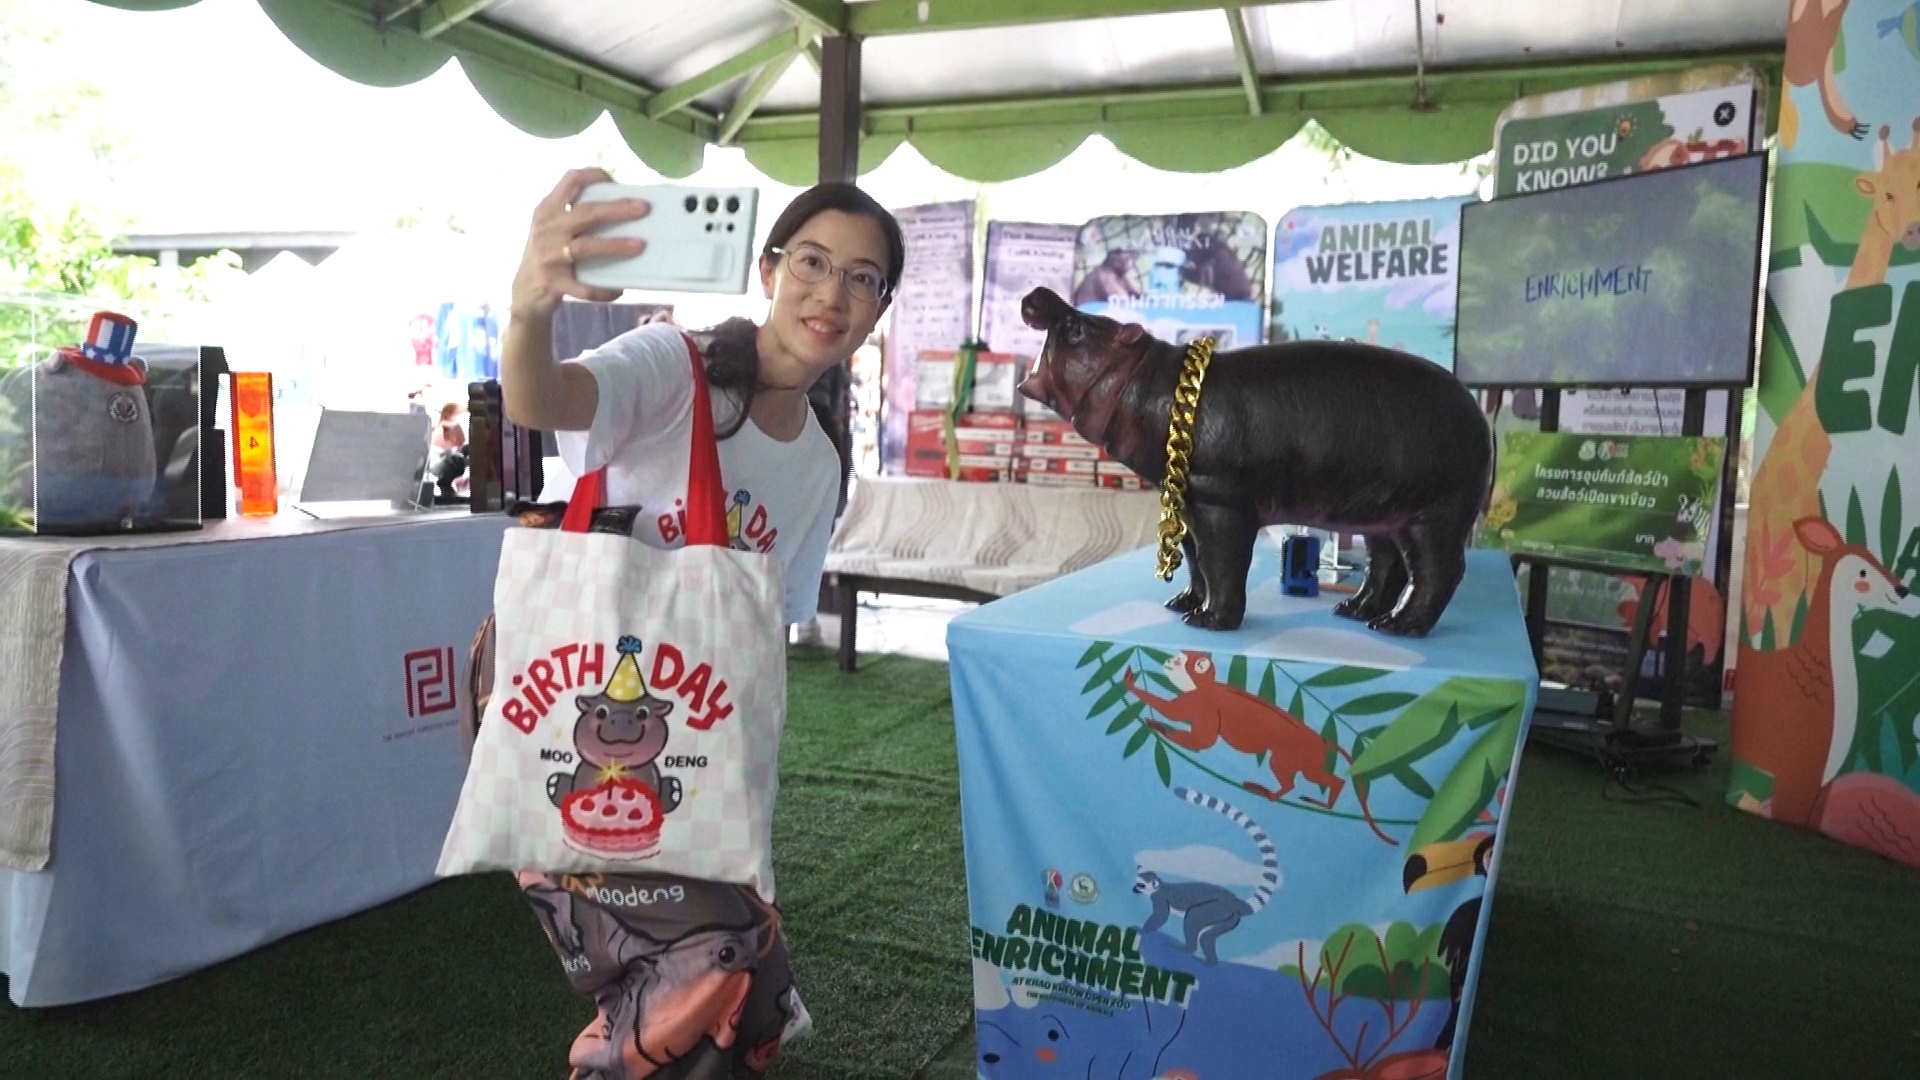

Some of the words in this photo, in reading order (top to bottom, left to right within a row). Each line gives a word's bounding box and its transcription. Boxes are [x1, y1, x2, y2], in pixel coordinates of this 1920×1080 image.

[1513, 141, 1558, 165] DID
[1566, 133, 1617, 159] YOU
[1516, 162, 1608, 192] KNOW?
[1318, 219, 1432, 253] ANIMAL
[1305, 244, 1448, 284] WELFARE
[1525, 264, 1653, 303] ENRICHMENT
[540, 749, 573, 764] MOO
[664, 755, 708, 768] DENG
[1006, 903, 1142, 961] ANIMAL
[972, 926, 1196, 1004] ENRICHMENT
[1012, 976, 1024, 986] AT
[1025, 978, 1052, 990] KHAO
